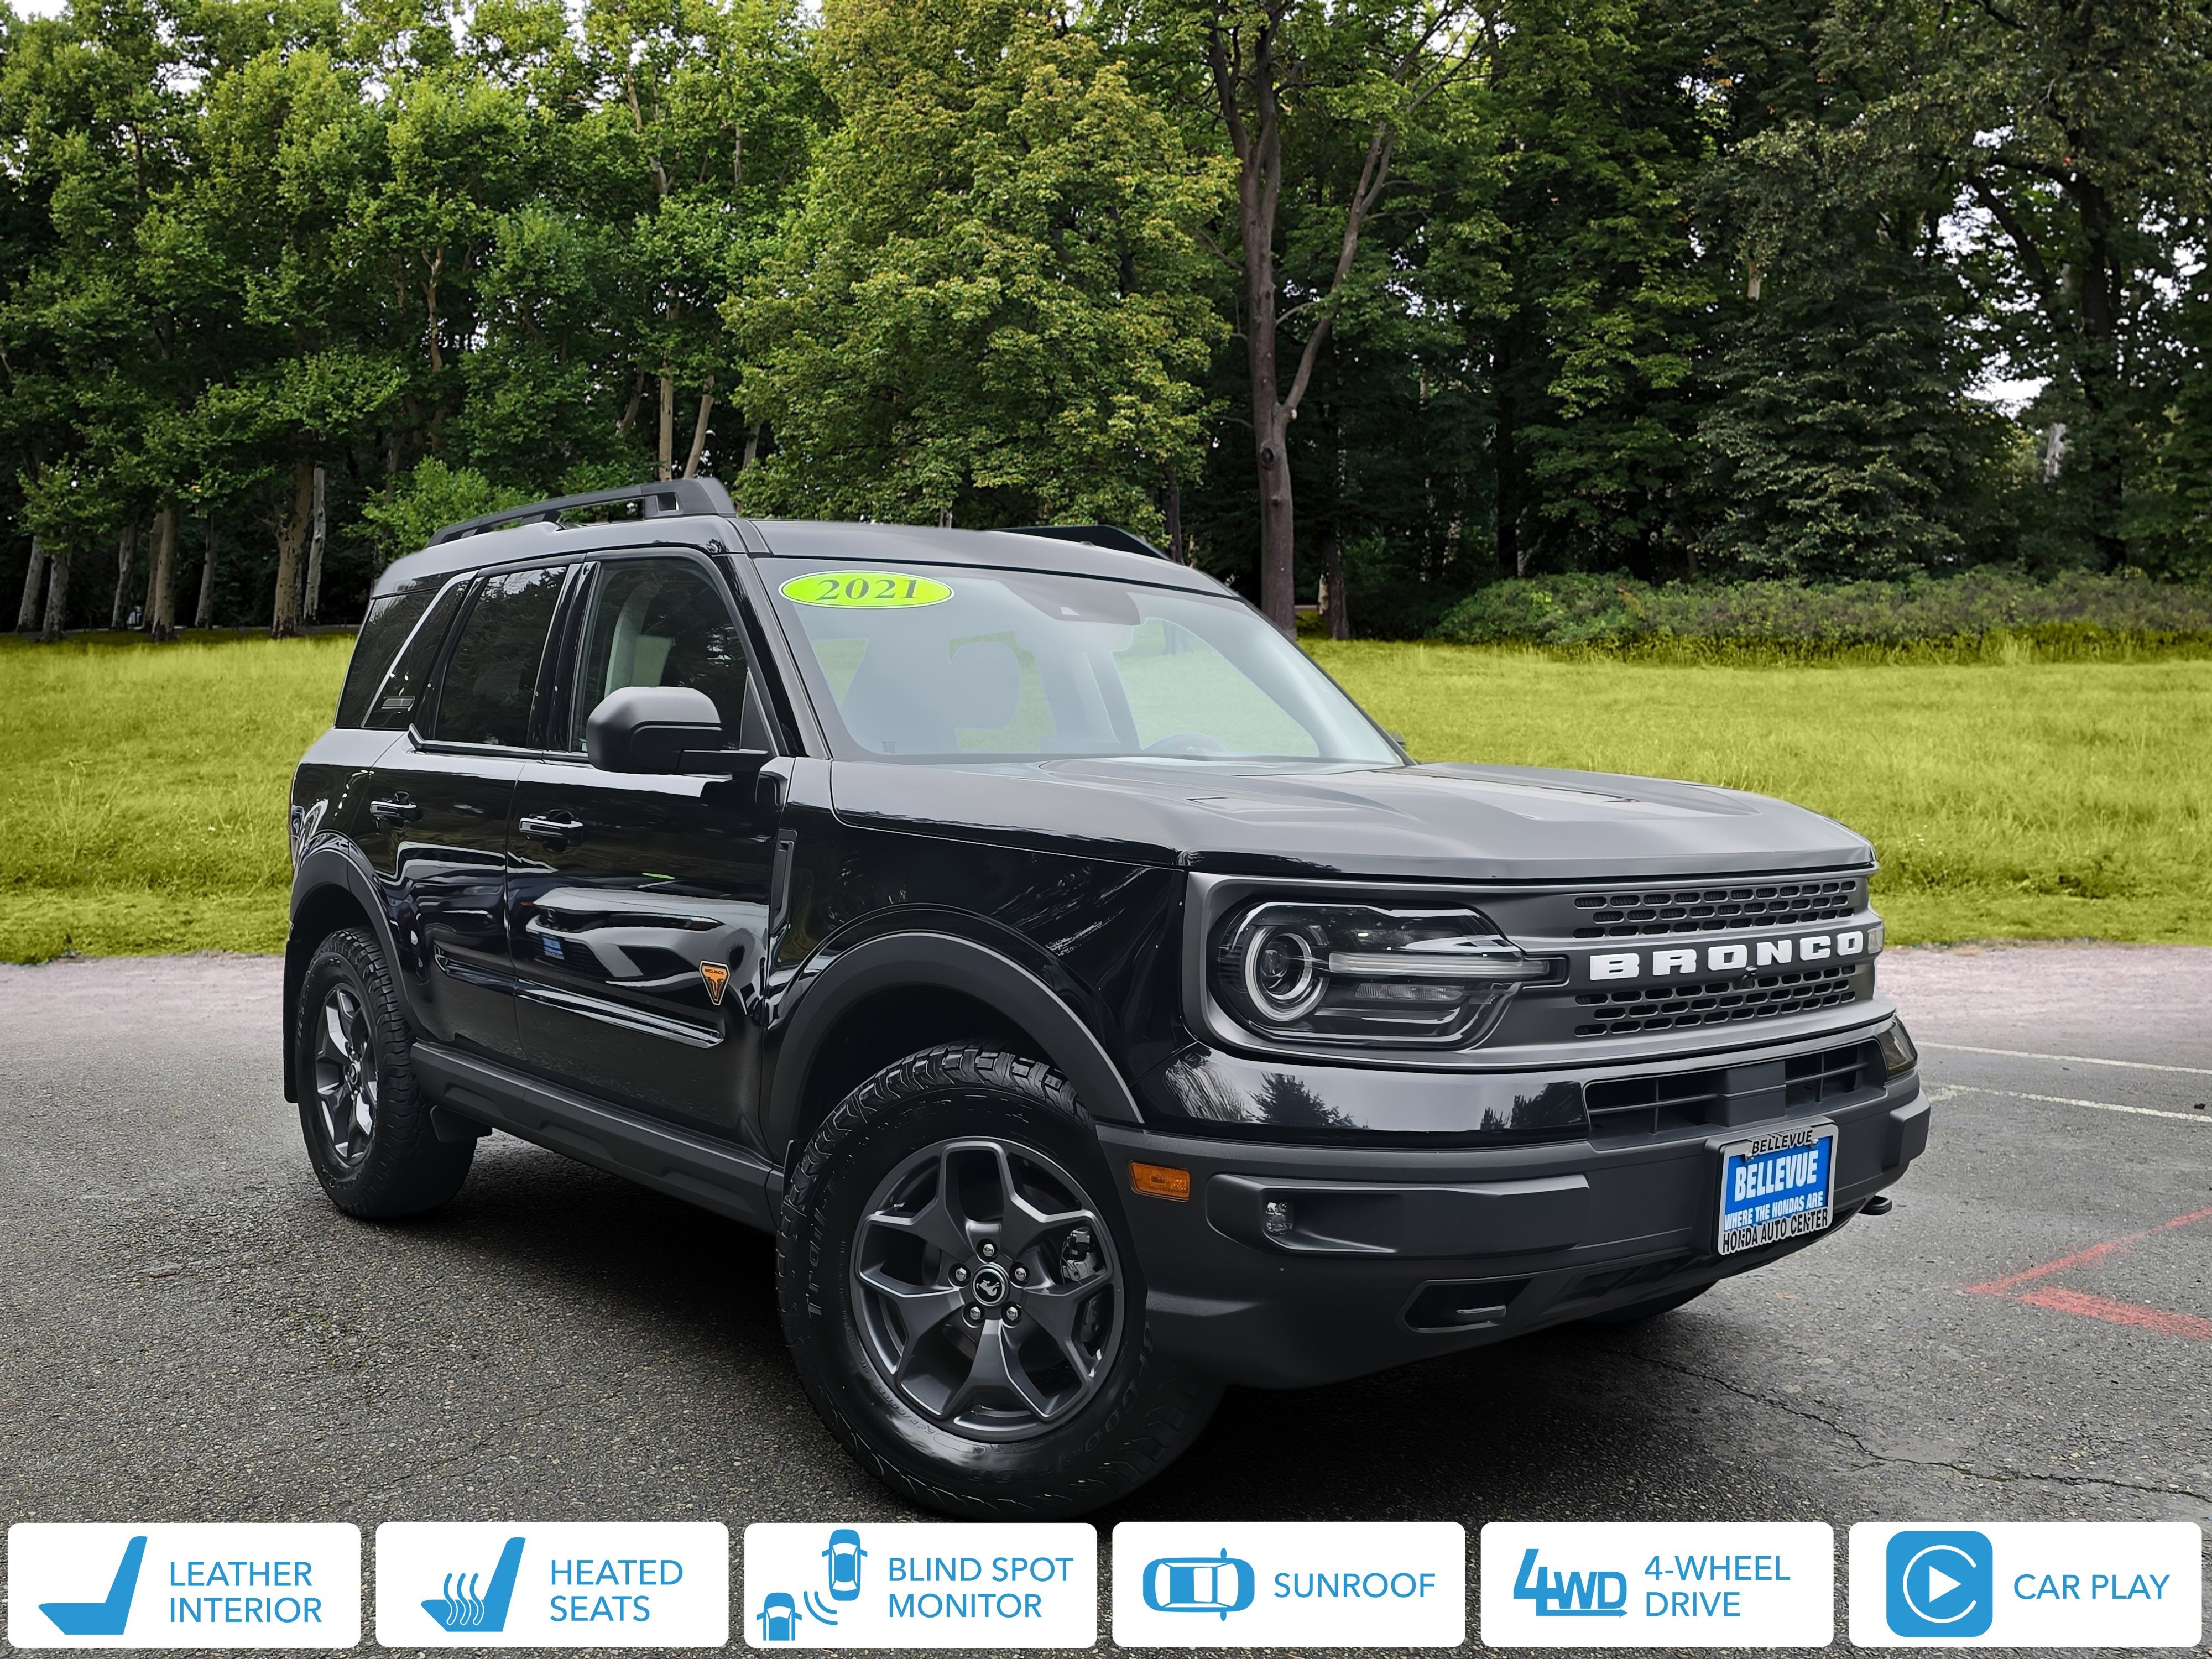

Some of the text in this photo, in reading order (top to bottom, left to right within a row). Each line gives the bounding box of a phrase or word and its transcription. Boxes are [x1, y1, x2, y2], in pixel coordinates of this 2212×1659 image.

[816, 578, 918, 601] 2021
[1590, 931, 1863, 980] BRONCO
[1752, 1130, 1813, 1154] BELLEVUE
[1734, 1150, 1819, 1202] BELLEVUE
[1723, 1209, 1828, 1253] HONDA AUTO CENTER
[1724, 1191, 1824, 1230] WHERE THE HONDAS ARE
